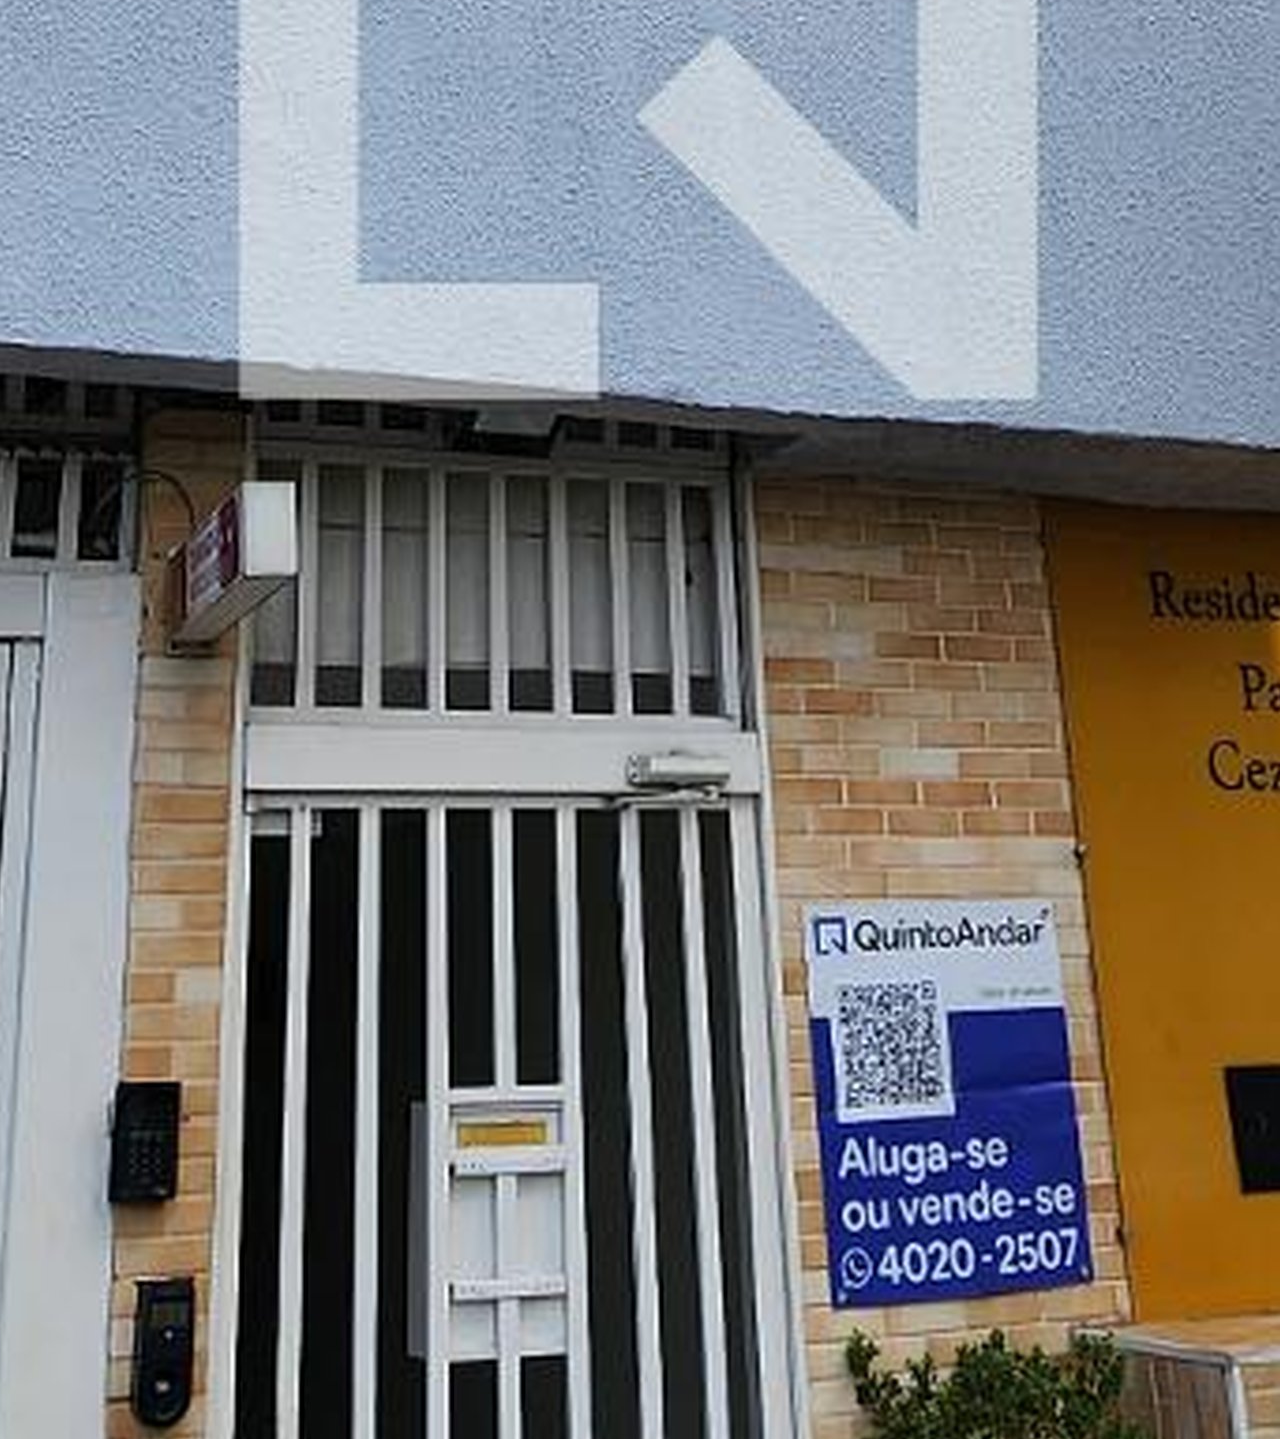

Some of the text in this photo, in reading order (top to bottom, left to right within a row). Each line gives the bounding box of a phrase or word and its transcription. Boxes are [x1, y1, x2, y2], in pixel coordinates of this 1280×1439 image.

[853, 916, 1045, 952] QuintoAndar
[839, 1136, 1008, 1184] Aluga-se
[841, 1179, 1075, 1232] ou vende-se
